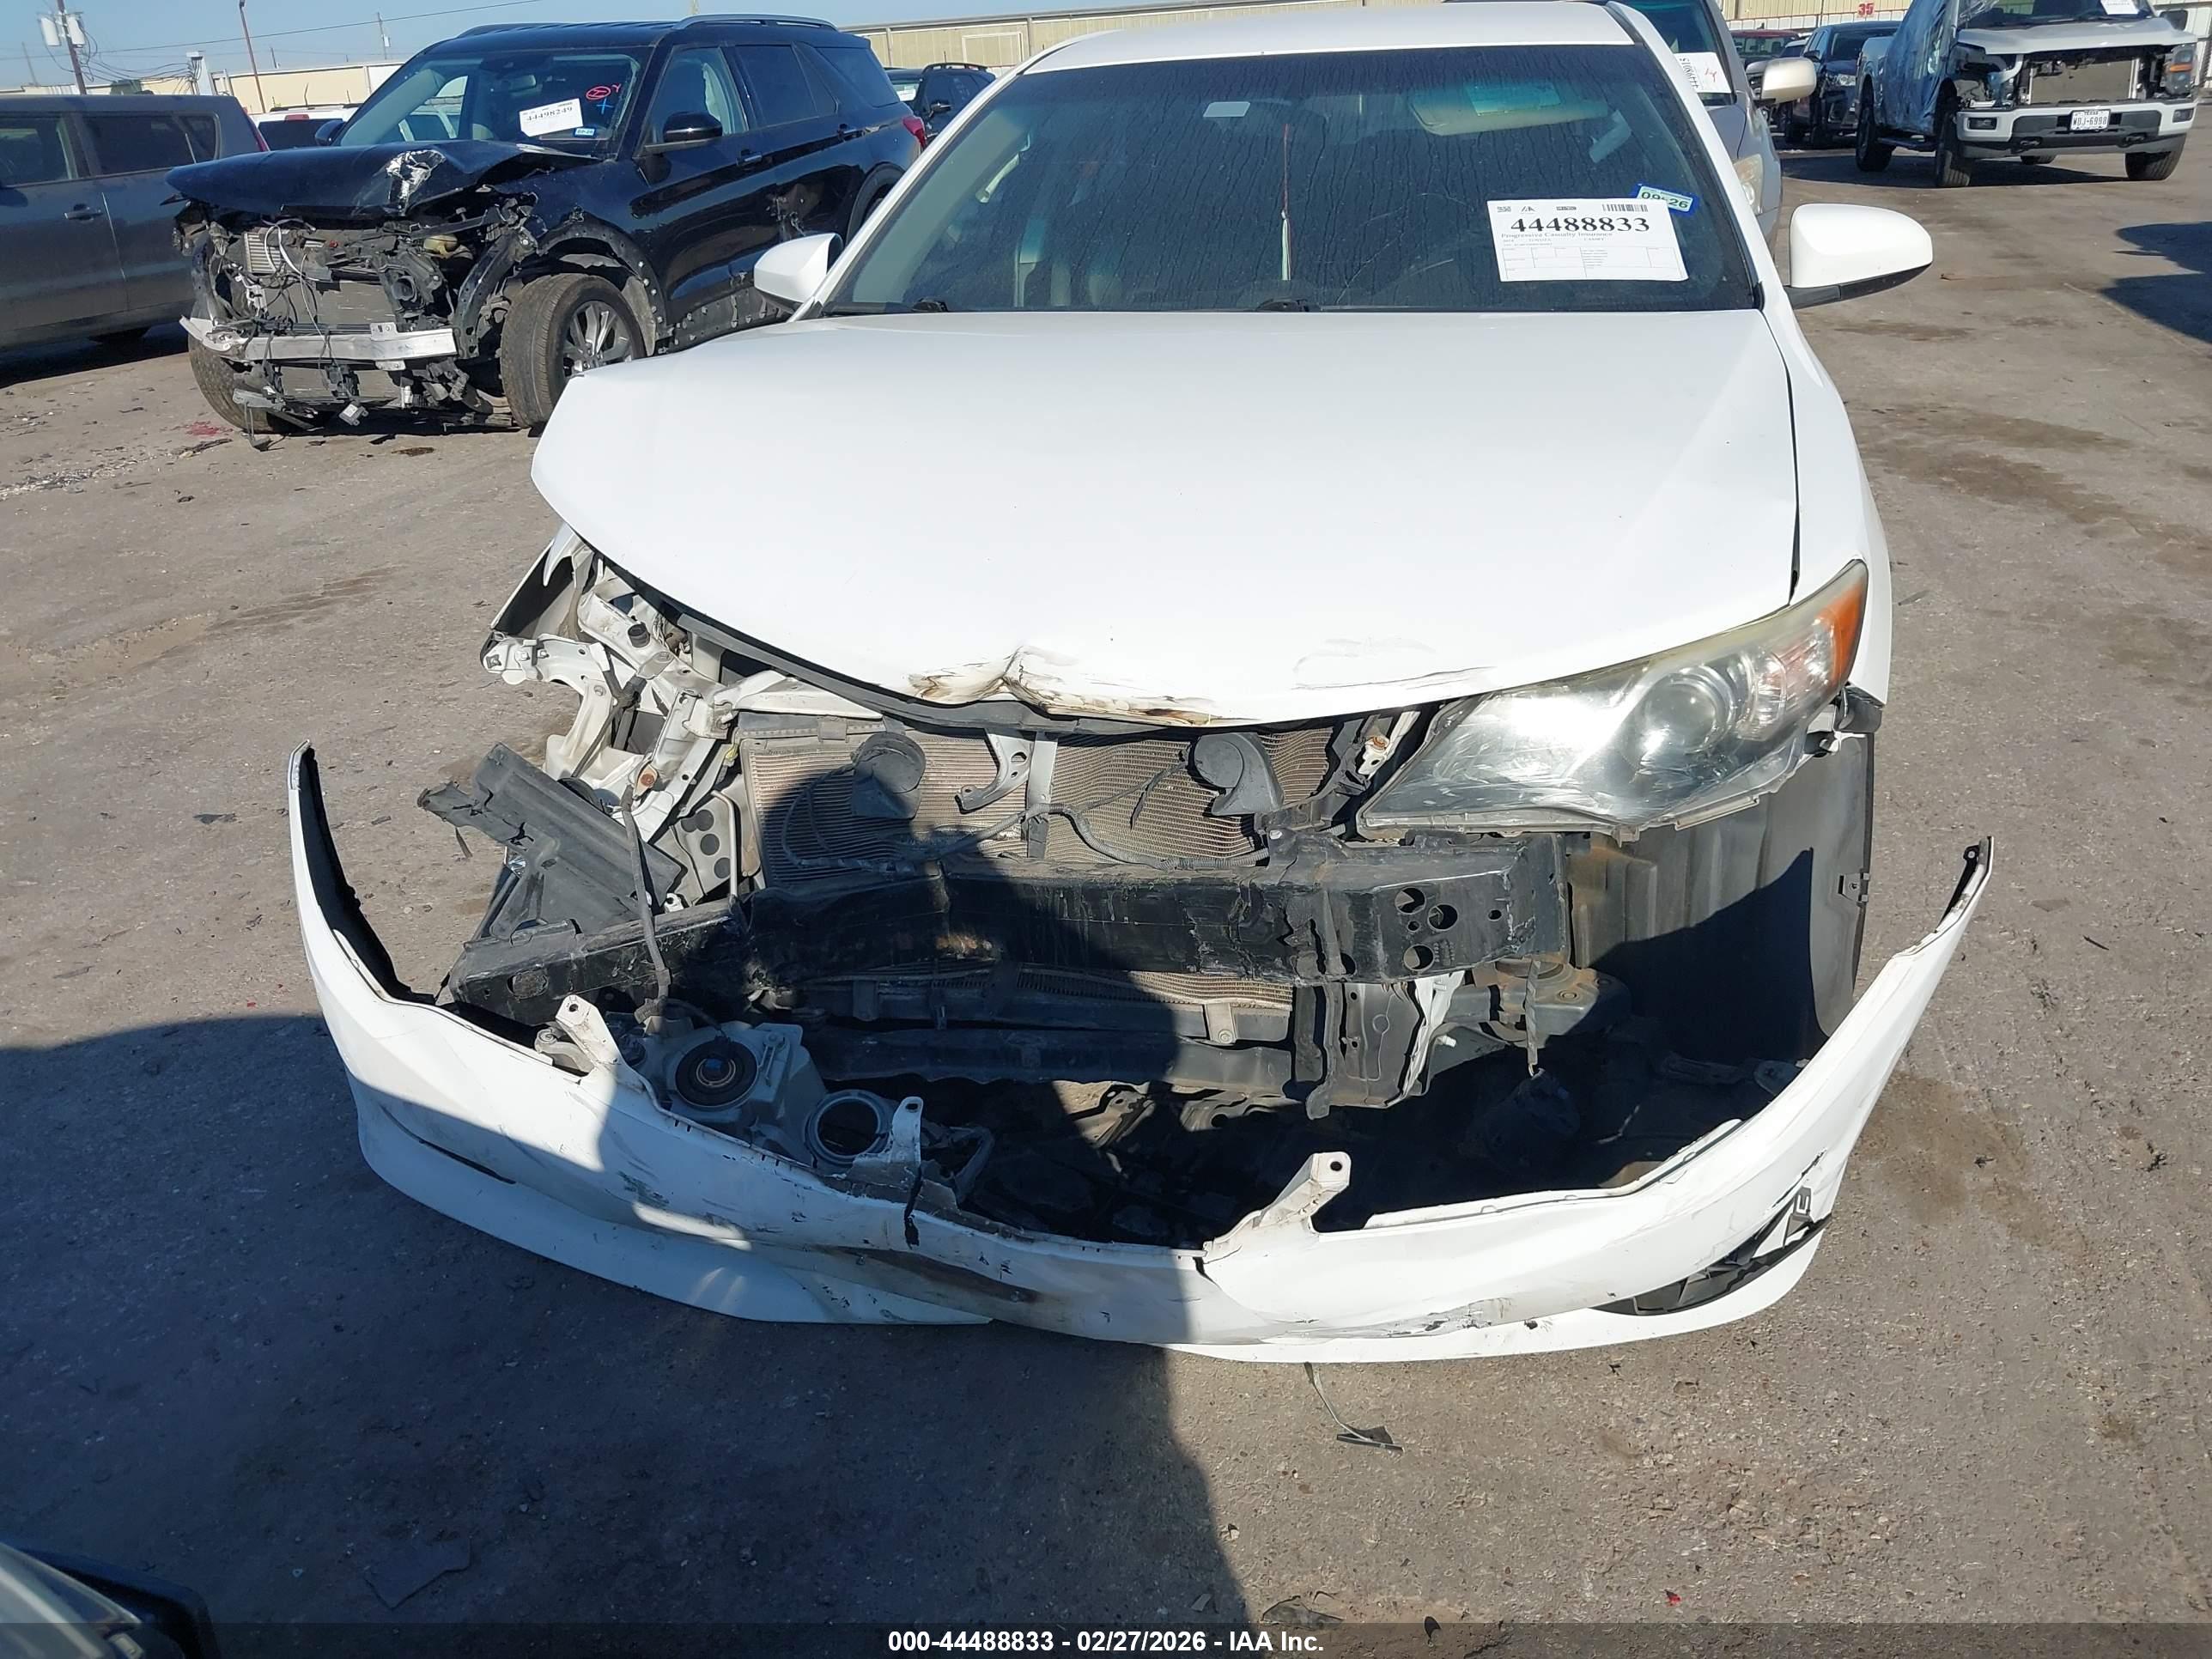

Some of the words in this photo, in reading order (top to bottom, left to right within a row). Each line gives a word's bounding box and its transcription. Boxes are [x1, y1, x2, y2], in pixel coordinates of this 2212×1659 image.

[1858, 3, 1874, 15] 35
[526, 106, 573, 121] 44498249
[1510, 217, 1650, 232] 44488833
